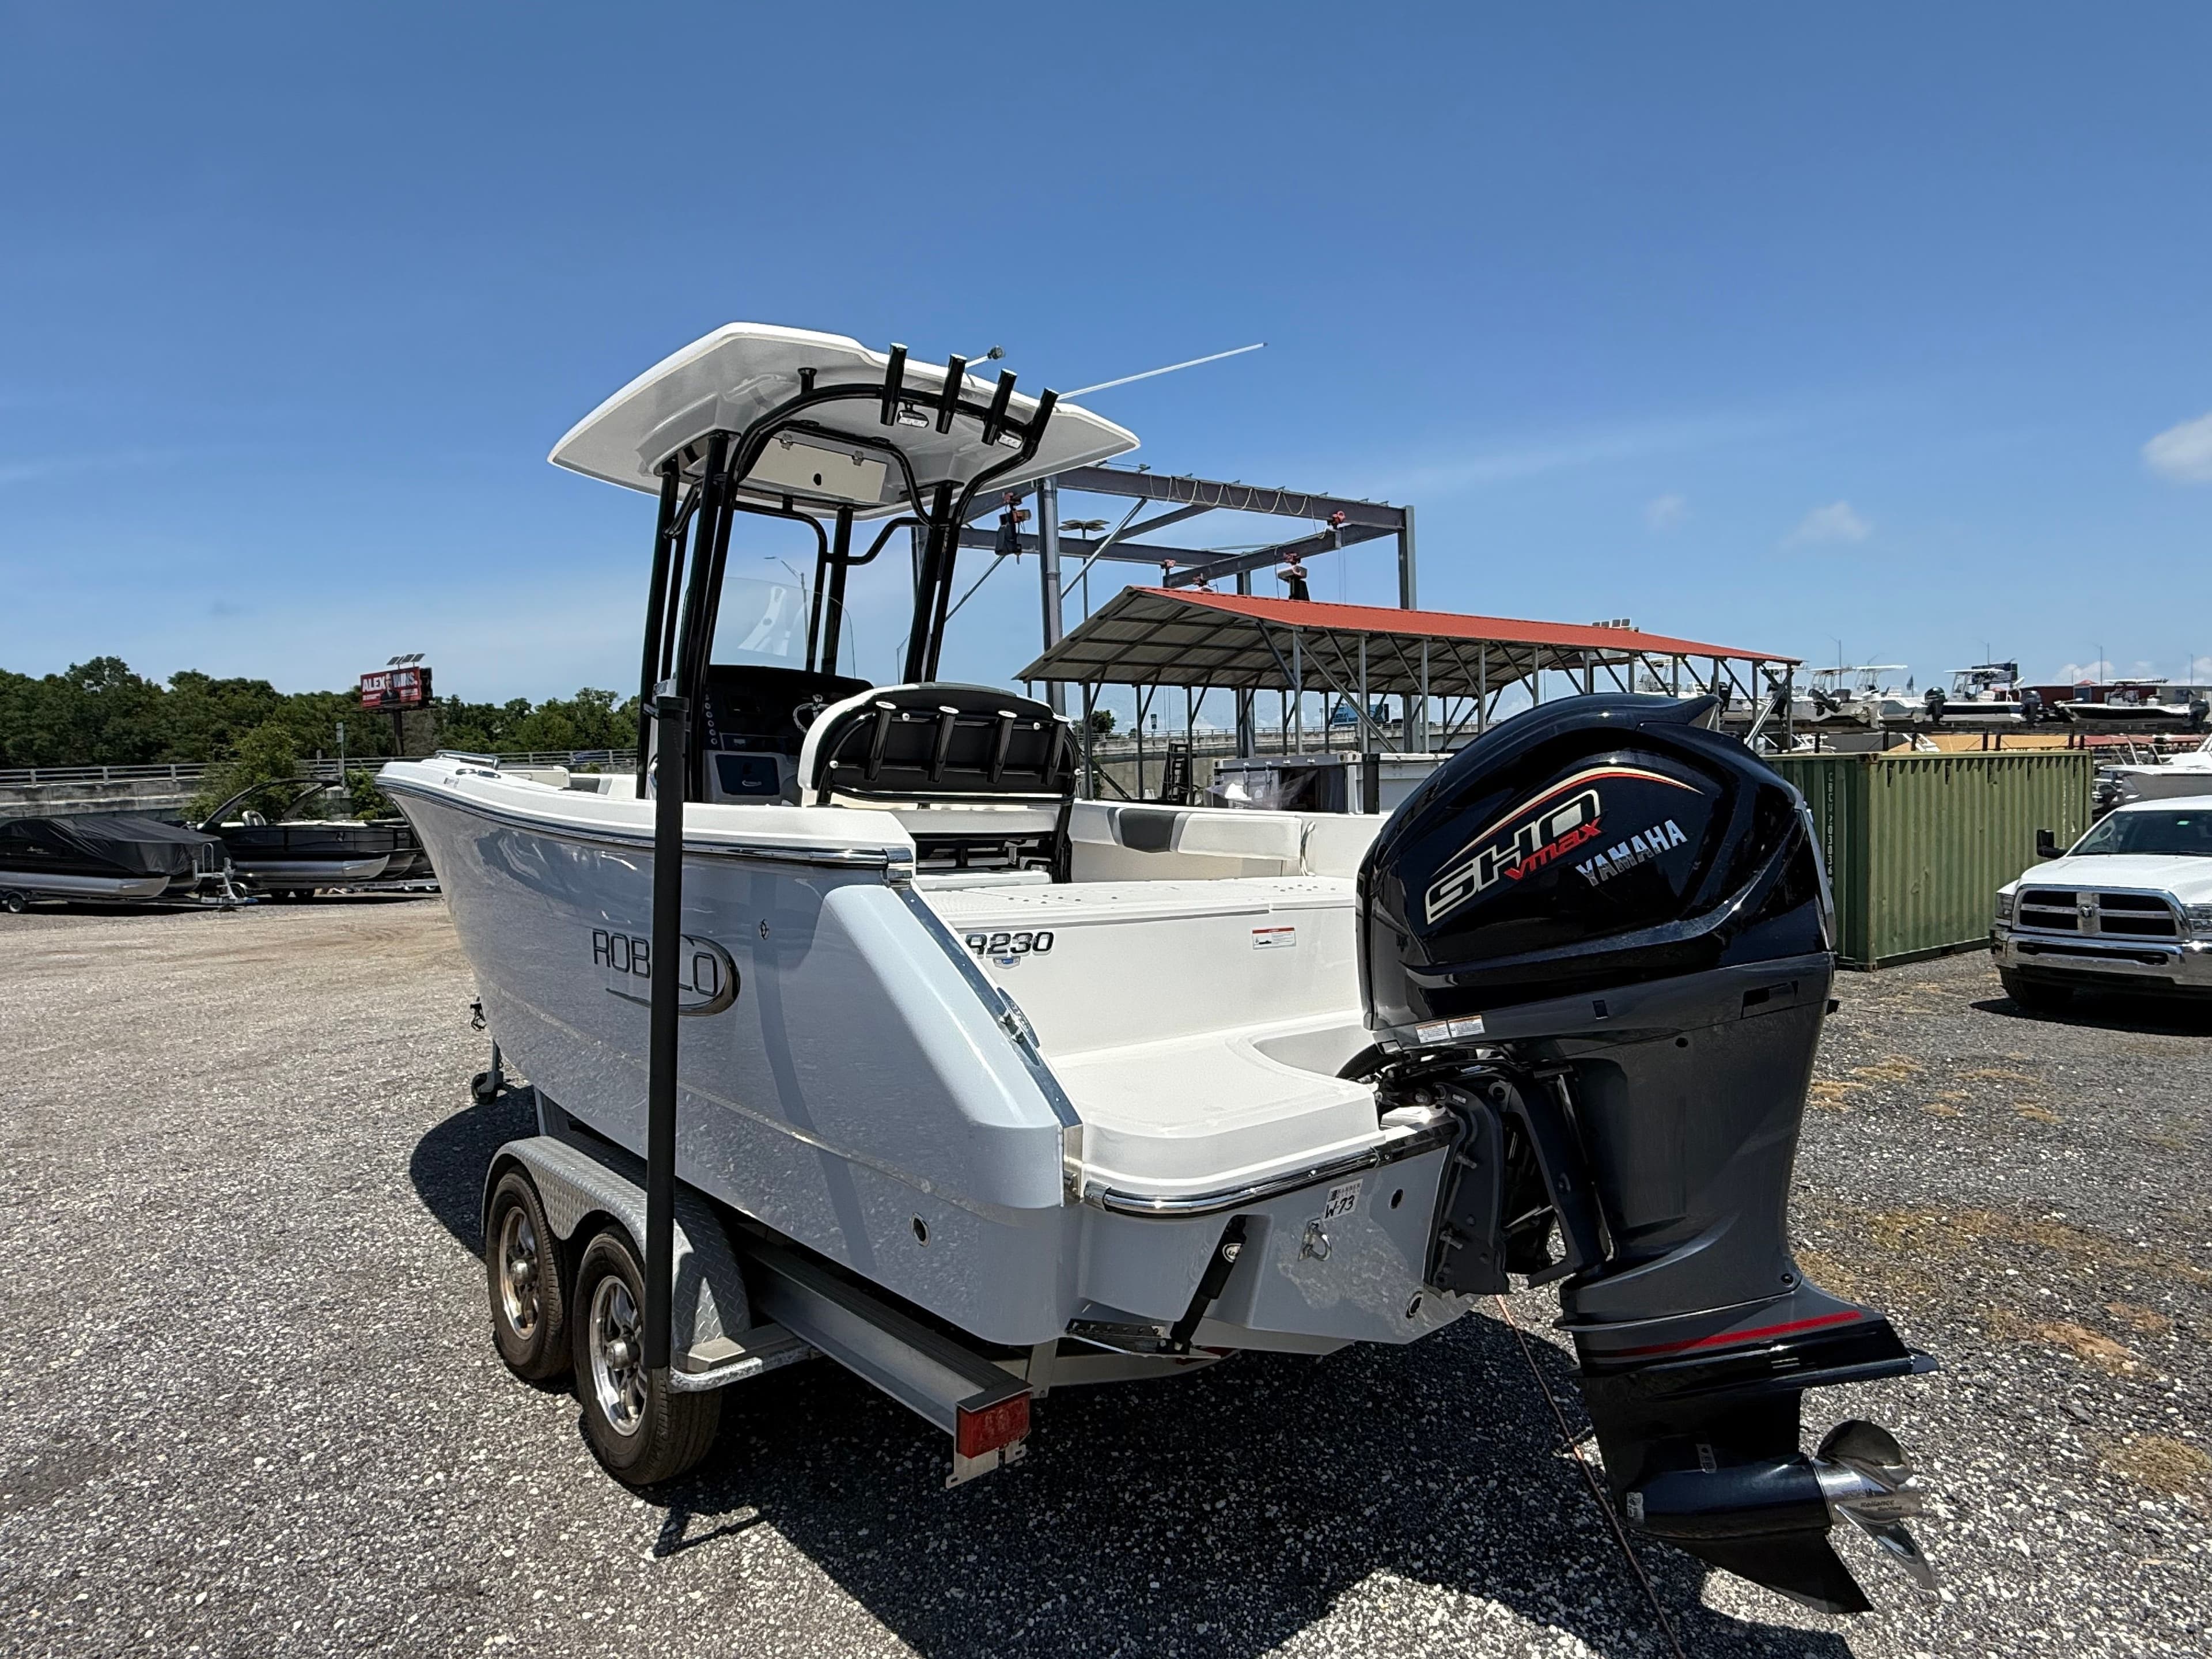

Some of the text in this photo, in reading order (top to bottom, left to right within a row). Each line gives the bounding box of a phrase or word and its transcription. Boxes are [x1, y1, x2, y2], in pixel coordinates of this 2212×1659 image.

[362, 676, 386, 692] ALEX
[1425, 789, 1601, 925] SHO
[1575, 820, 1687, 887] YAMAHA
[965, 931, 1054, 957] R230
[592, 928, 718, 997] ROBO
[1324, 1195, 1355, 1219] W-73
[1860, 1499, 1895, 1508] Reliance
